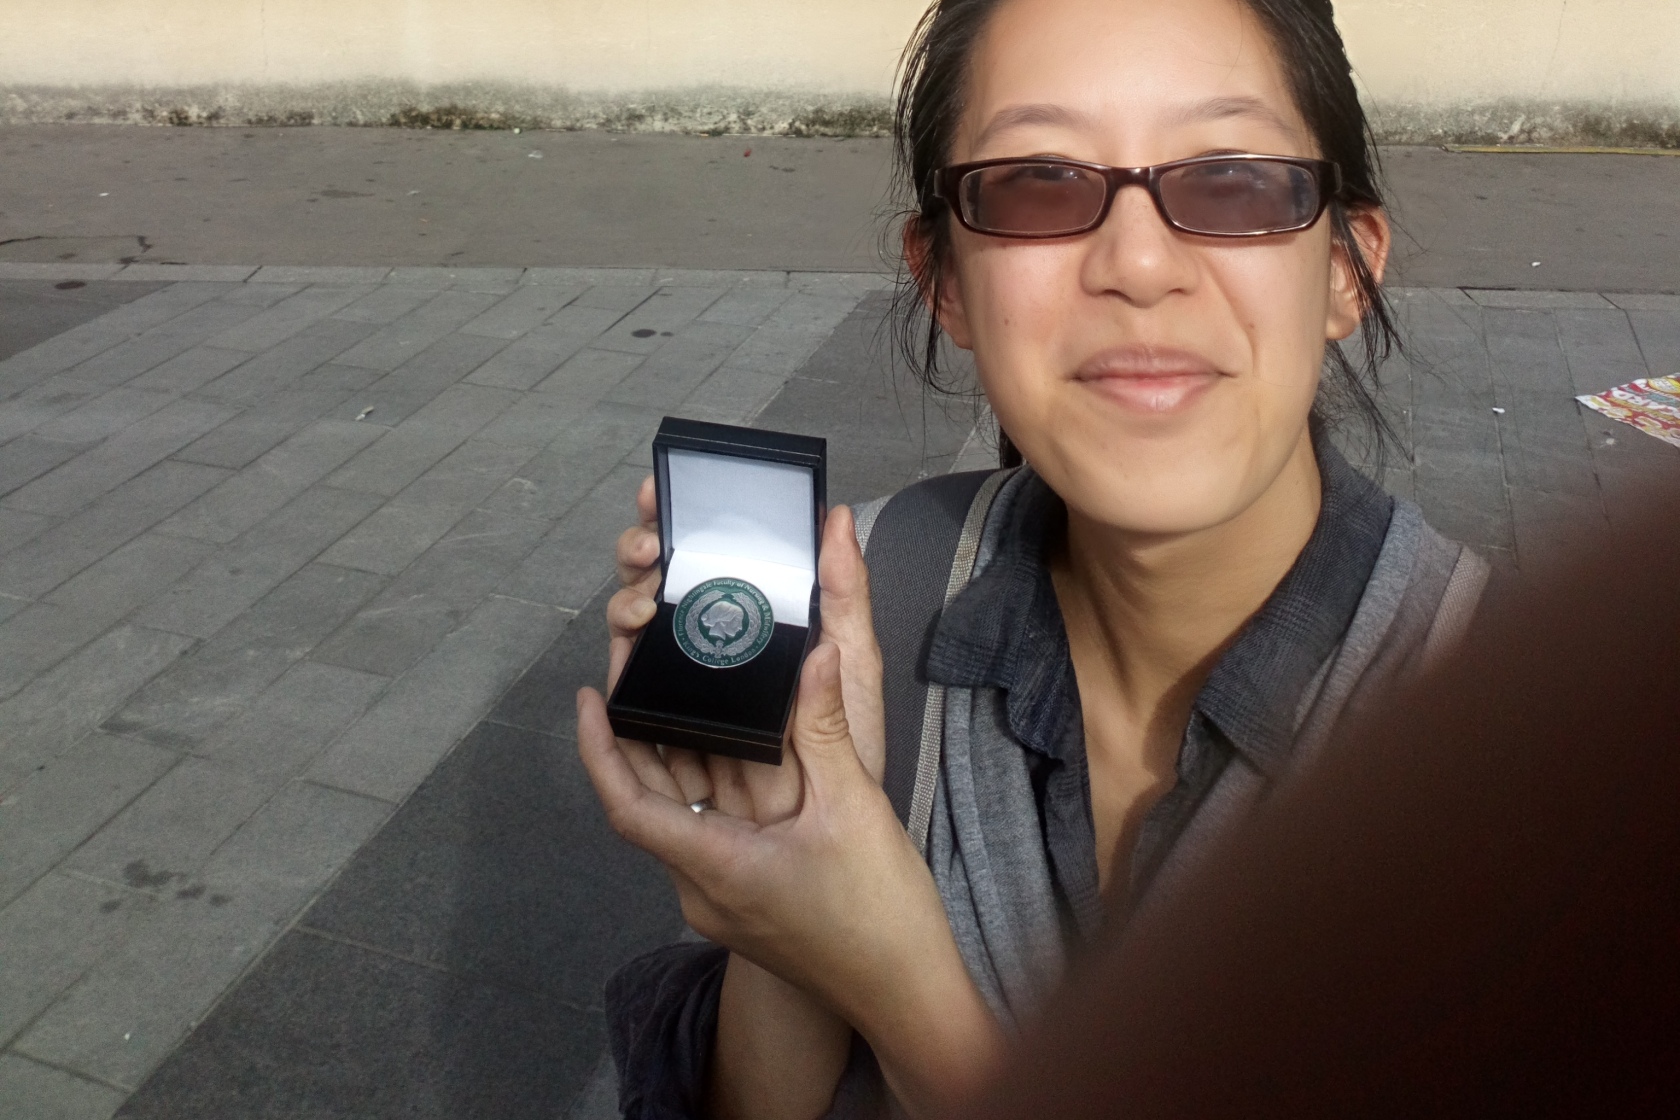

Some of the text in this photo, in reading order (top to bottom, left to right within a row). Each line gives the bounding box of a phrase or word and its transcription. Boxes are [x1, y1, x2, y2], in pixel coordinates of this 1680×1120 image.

[681, 582, 712, 609] Nightingale
[713, 579, 736, 587] Faculty
[744, 584, 765, 606] Nursing
[702, 655, 729, 666] College
[730, 648, 756, 663] London
